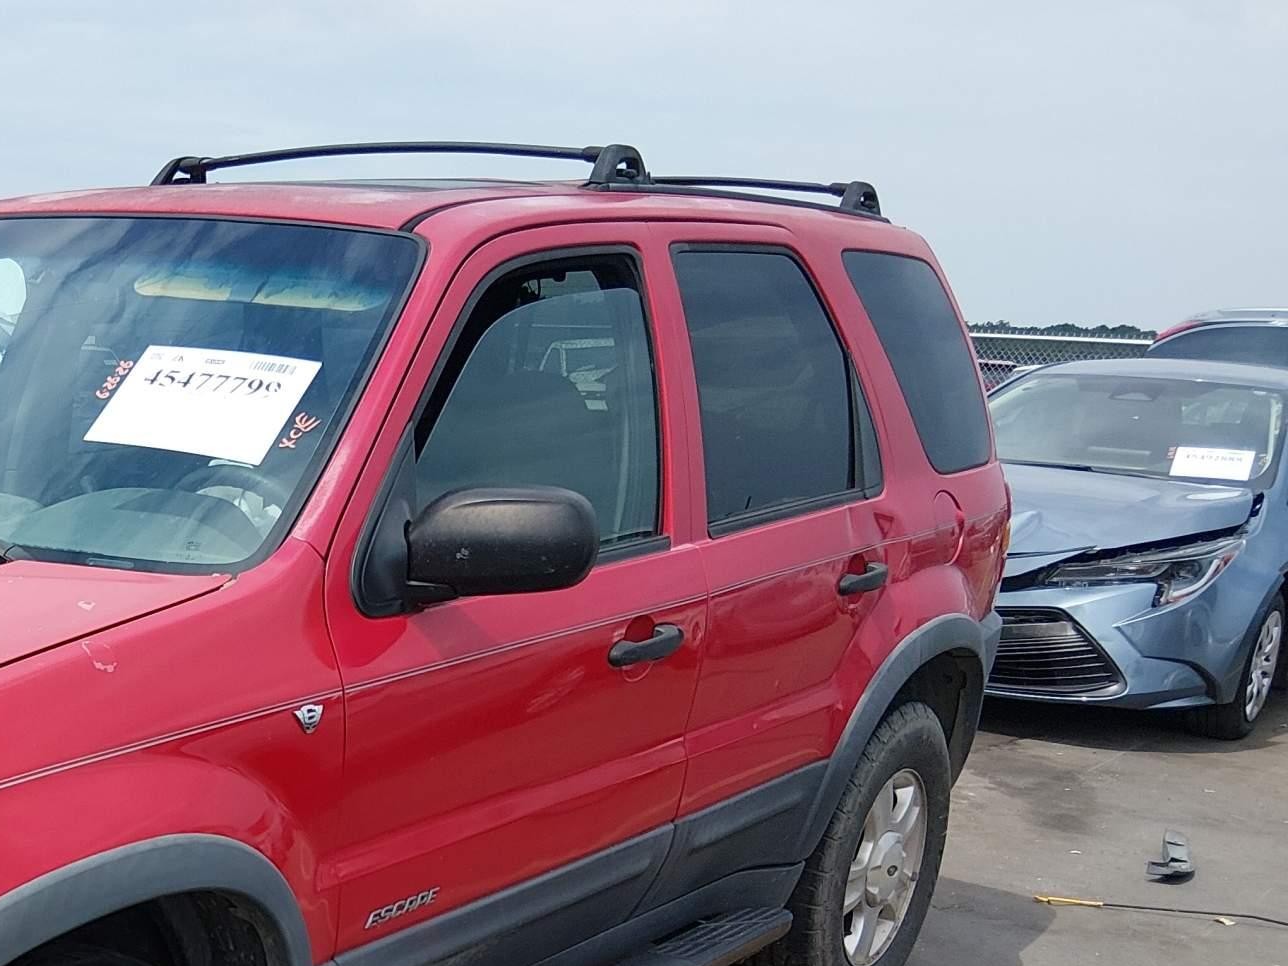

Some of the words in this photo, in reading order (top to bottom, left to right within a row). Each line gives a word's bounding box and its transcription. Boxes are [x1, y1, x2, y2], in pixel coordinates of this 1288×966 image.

[95, 360, 134, 399] 6-26-26
[144, 368, 282, 398] 45477799
[364, 886, 441, 929] ESCAPE
